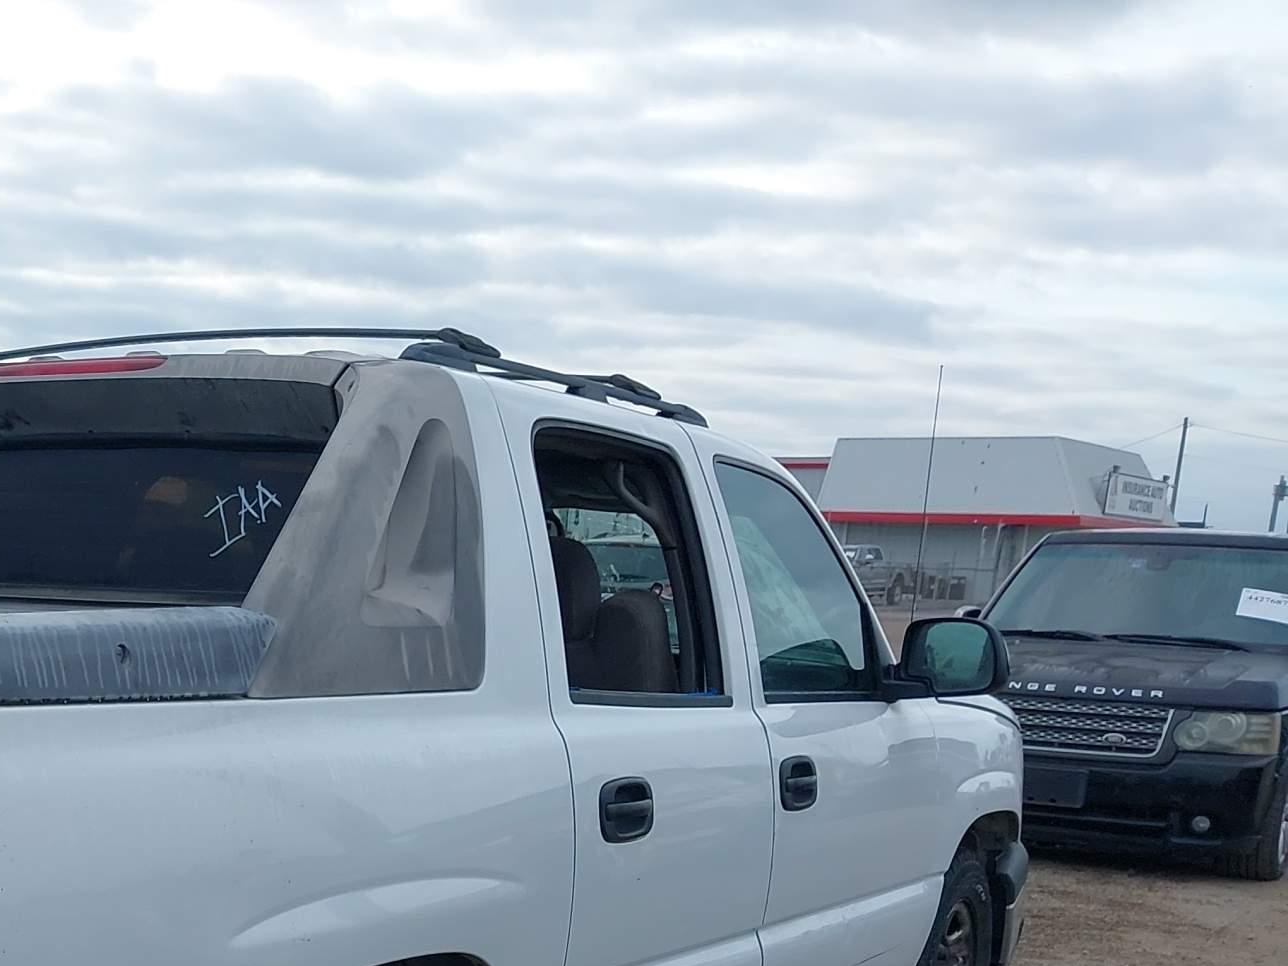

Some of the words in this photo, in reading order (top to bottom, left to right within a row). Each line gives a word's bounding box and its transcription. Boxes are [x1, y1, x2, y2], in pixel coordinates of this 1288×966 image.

[203, 480, 282, 557] IAA
[1008, 681, 1057, 692] NGE
[1074, 685, 1164, 698] ROVER
